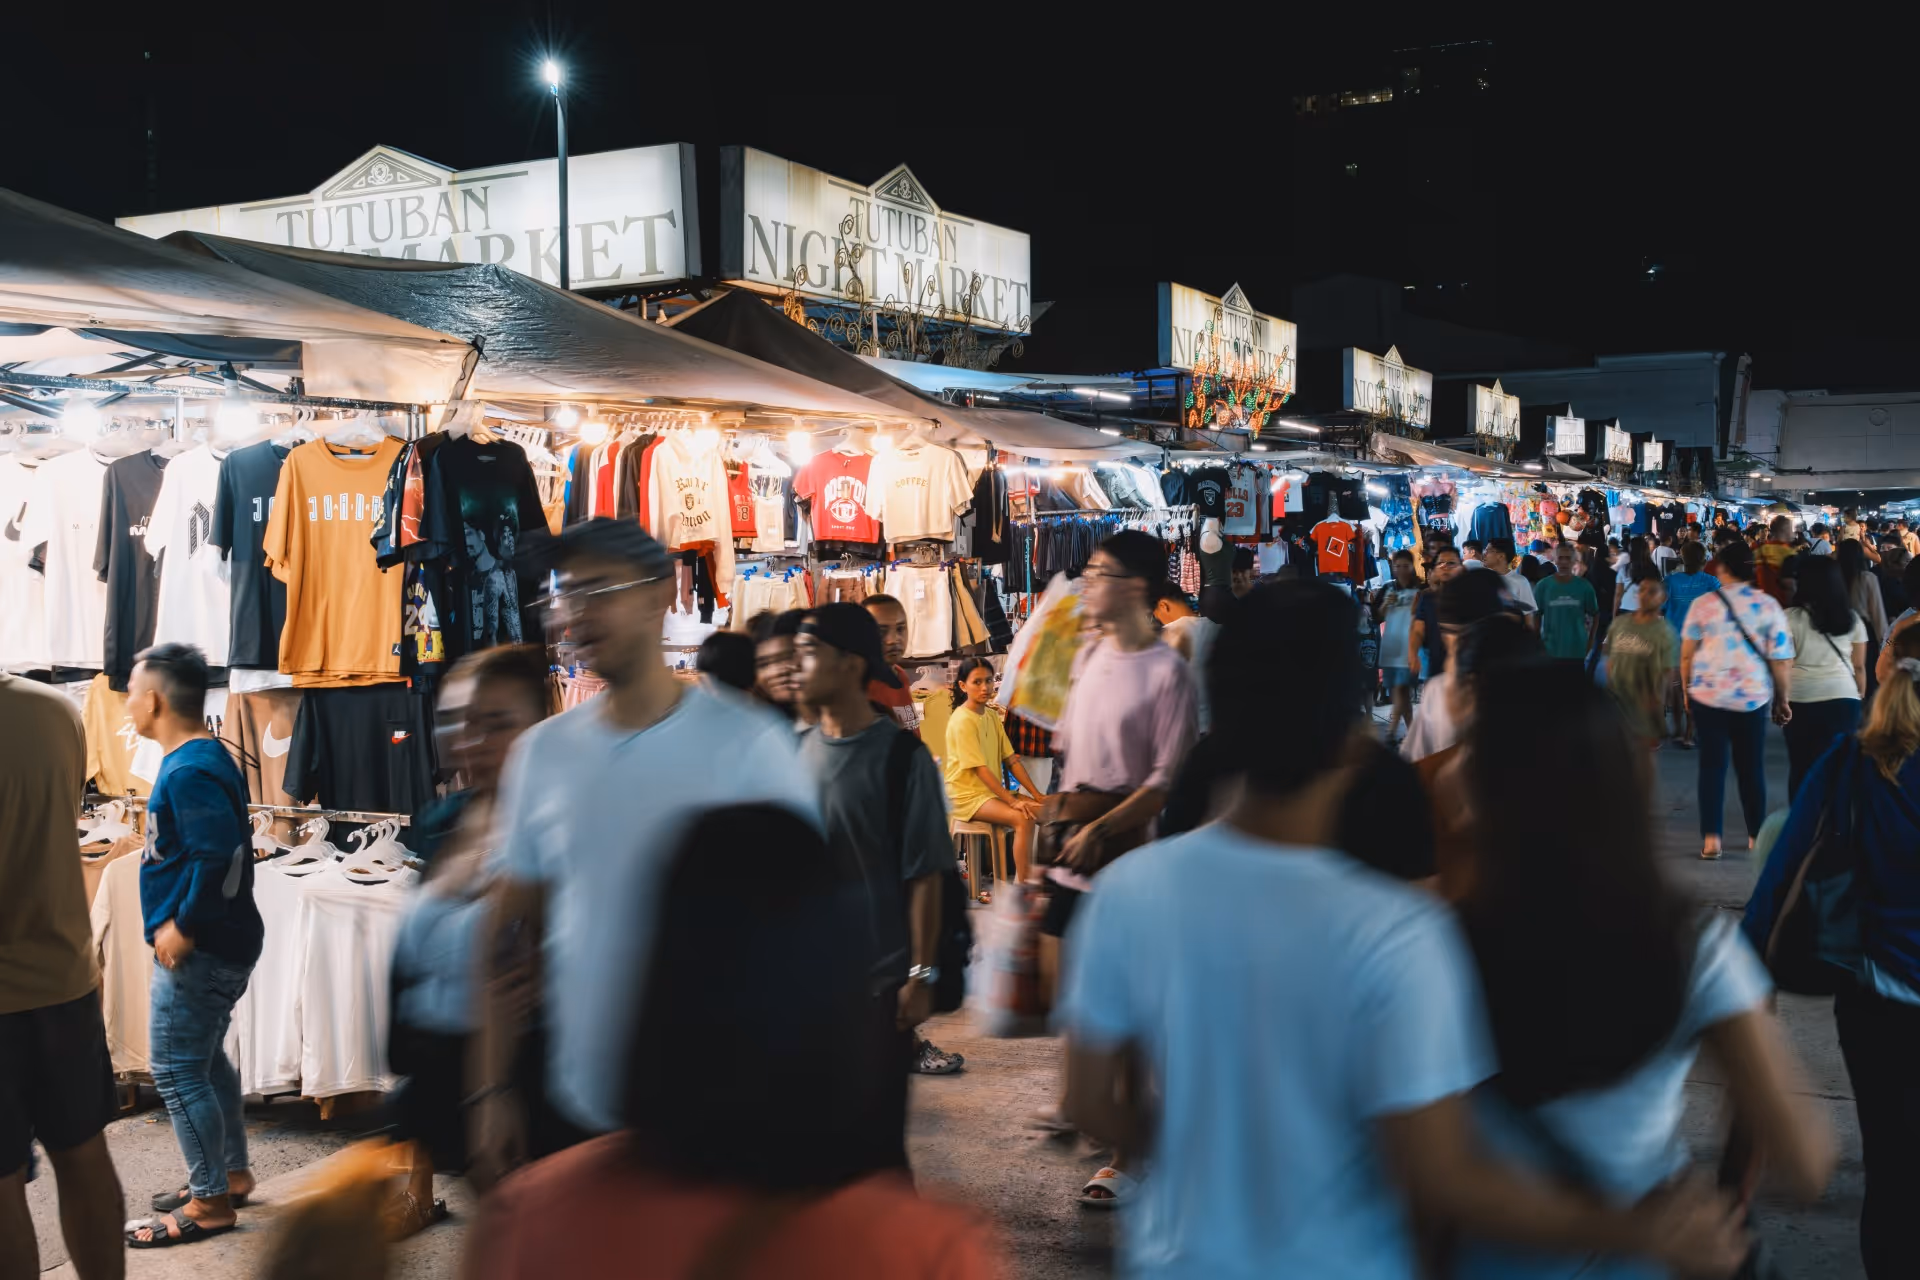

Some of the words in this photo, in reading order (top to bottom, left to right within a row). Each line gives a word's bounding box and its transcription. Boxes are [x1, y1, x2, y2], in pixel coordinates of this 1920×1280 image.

[275, 186, 491, 250] TUTUBAN
[361, 209, 677, 284] RKET
[850, 196, 958, 264] TUTUBAN
[1226, 501, 1245, 517] 23
